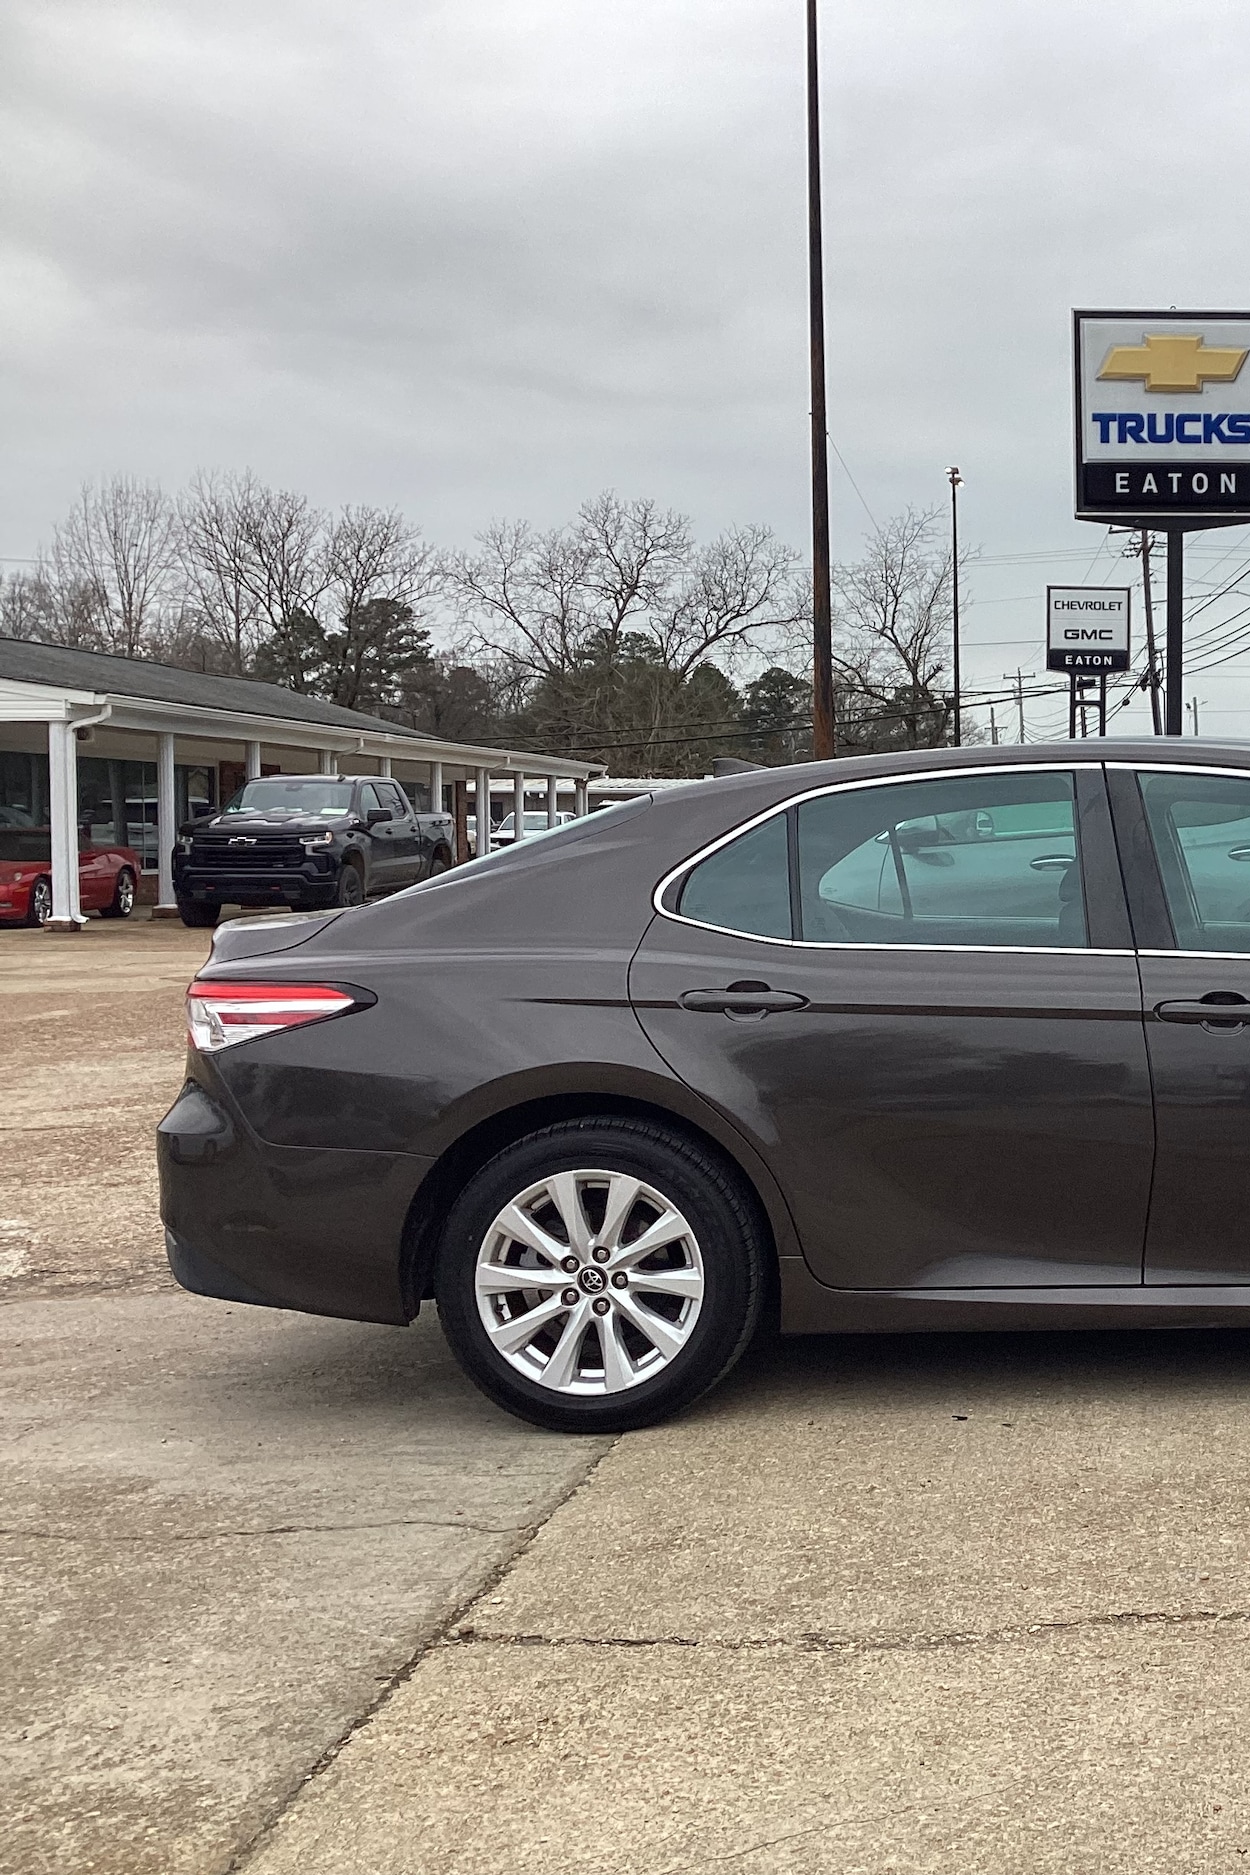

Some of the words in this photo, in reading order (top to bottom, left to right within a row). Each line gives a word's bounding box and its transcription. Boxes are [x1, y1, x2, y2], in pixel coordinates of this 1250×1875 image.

[1115, 472, 1236, 494] EATON
[1054, 600, 1123, 611] CHEVROLET
[1064, 629, 1113, 640] GMC
[1065, 655, 1112, 666] EATON
